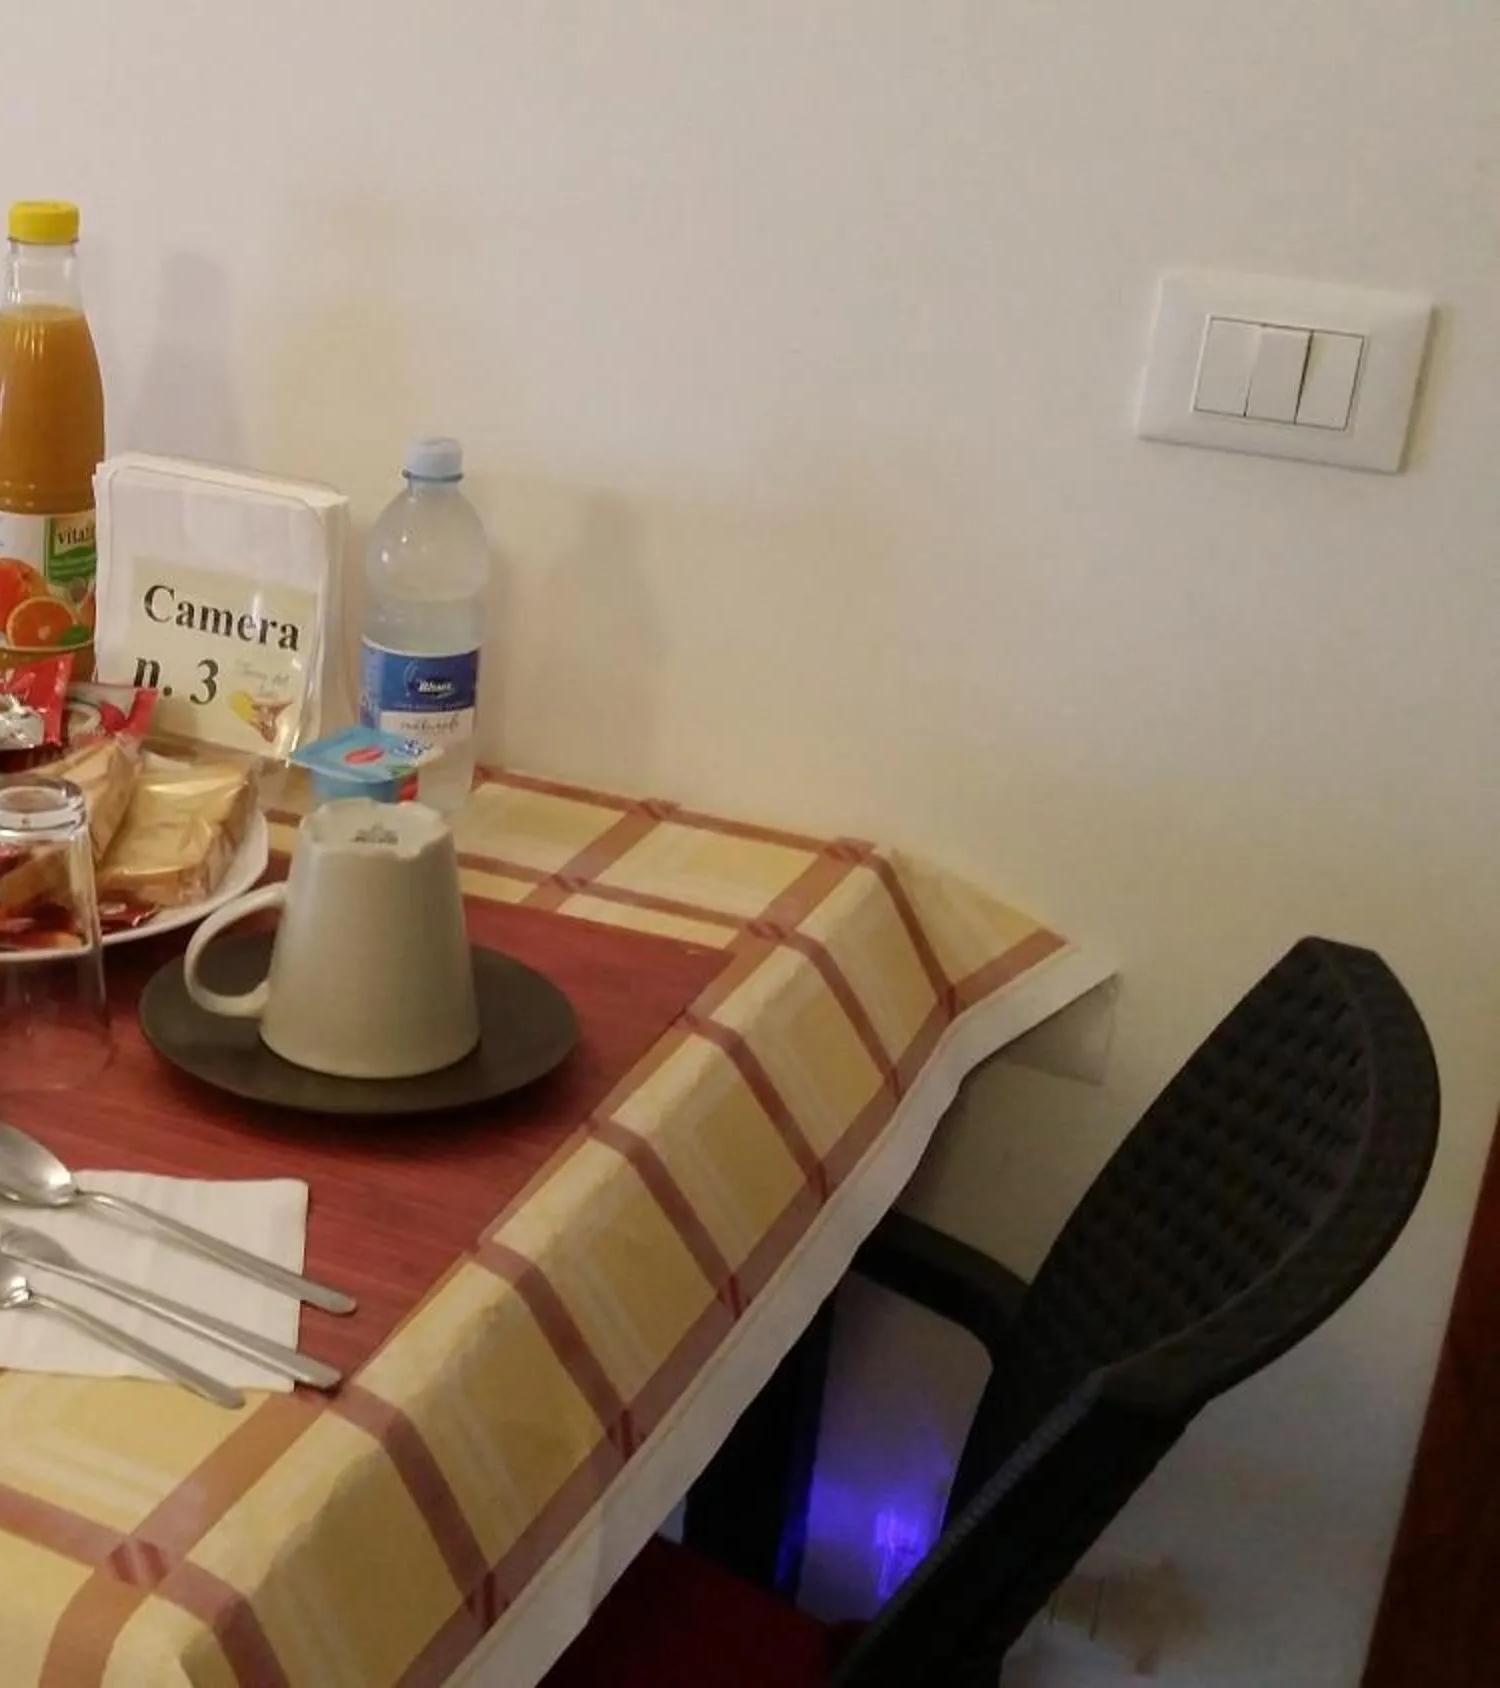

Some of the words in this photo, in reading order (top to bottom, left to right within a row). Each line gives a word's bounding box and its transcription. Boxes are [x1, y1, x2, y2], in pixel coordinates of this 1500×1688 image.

[143, 584, 300, 651] Camera
[133, 656, 173, 697] n.
[189, 658, 220, 706] 3
